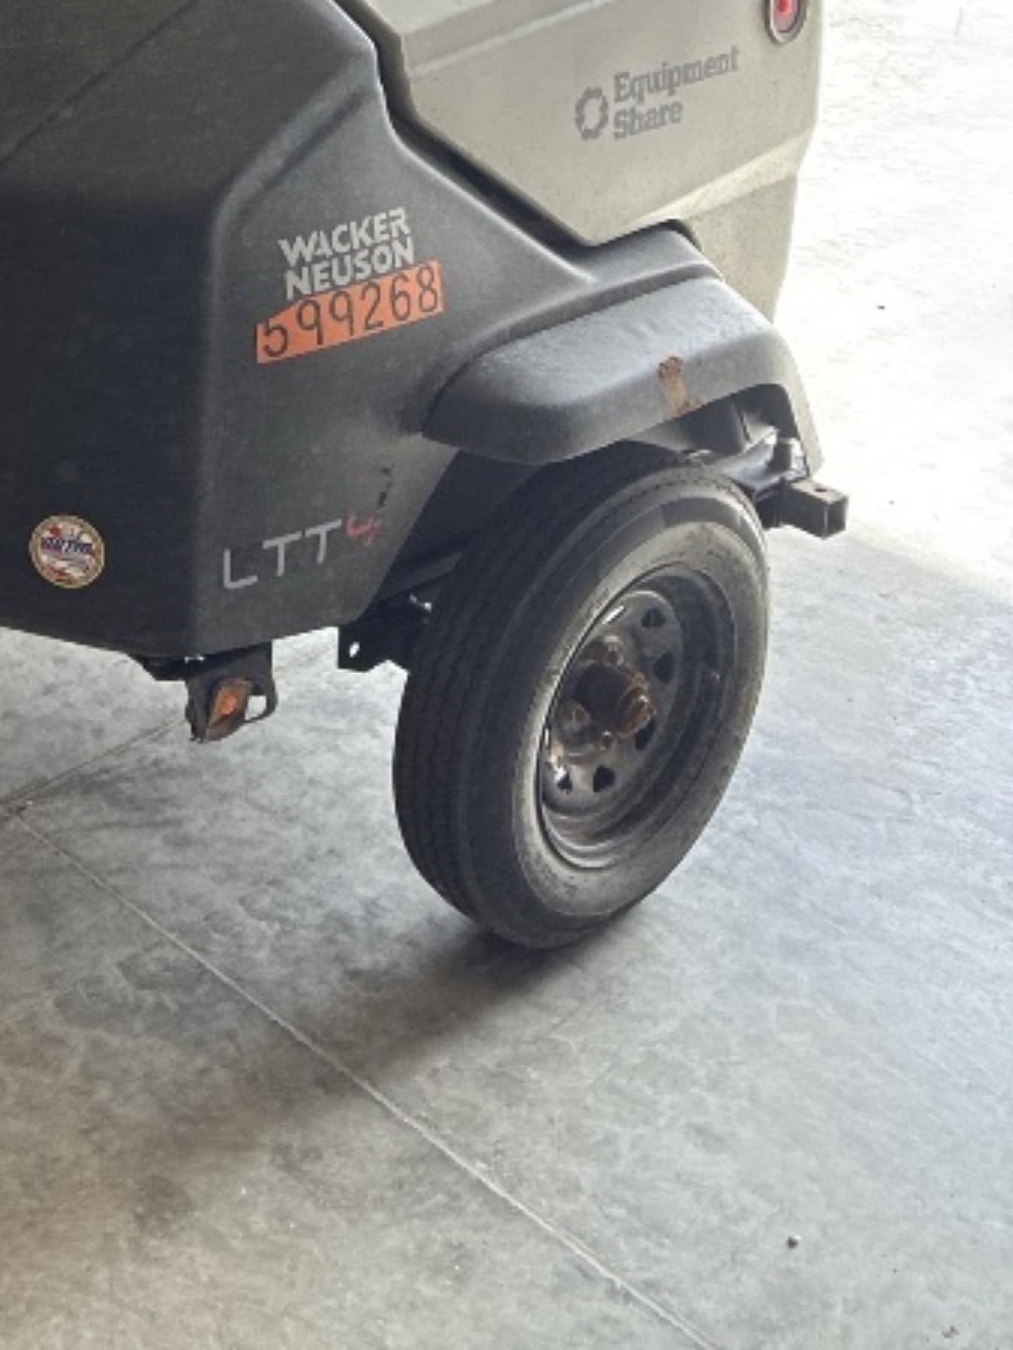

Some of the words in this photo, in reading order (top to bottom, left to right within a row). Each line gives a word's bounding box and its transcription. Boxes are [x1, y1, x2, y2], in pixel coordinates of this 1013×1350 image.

[614, 45, 741, 104] Equipment
[613, 101, 684, 140] Share
[278, 206, 412, 268] WACKER
[284, 236, 416, 301] NEUSON
[261, 265, 440, 358] 599268
